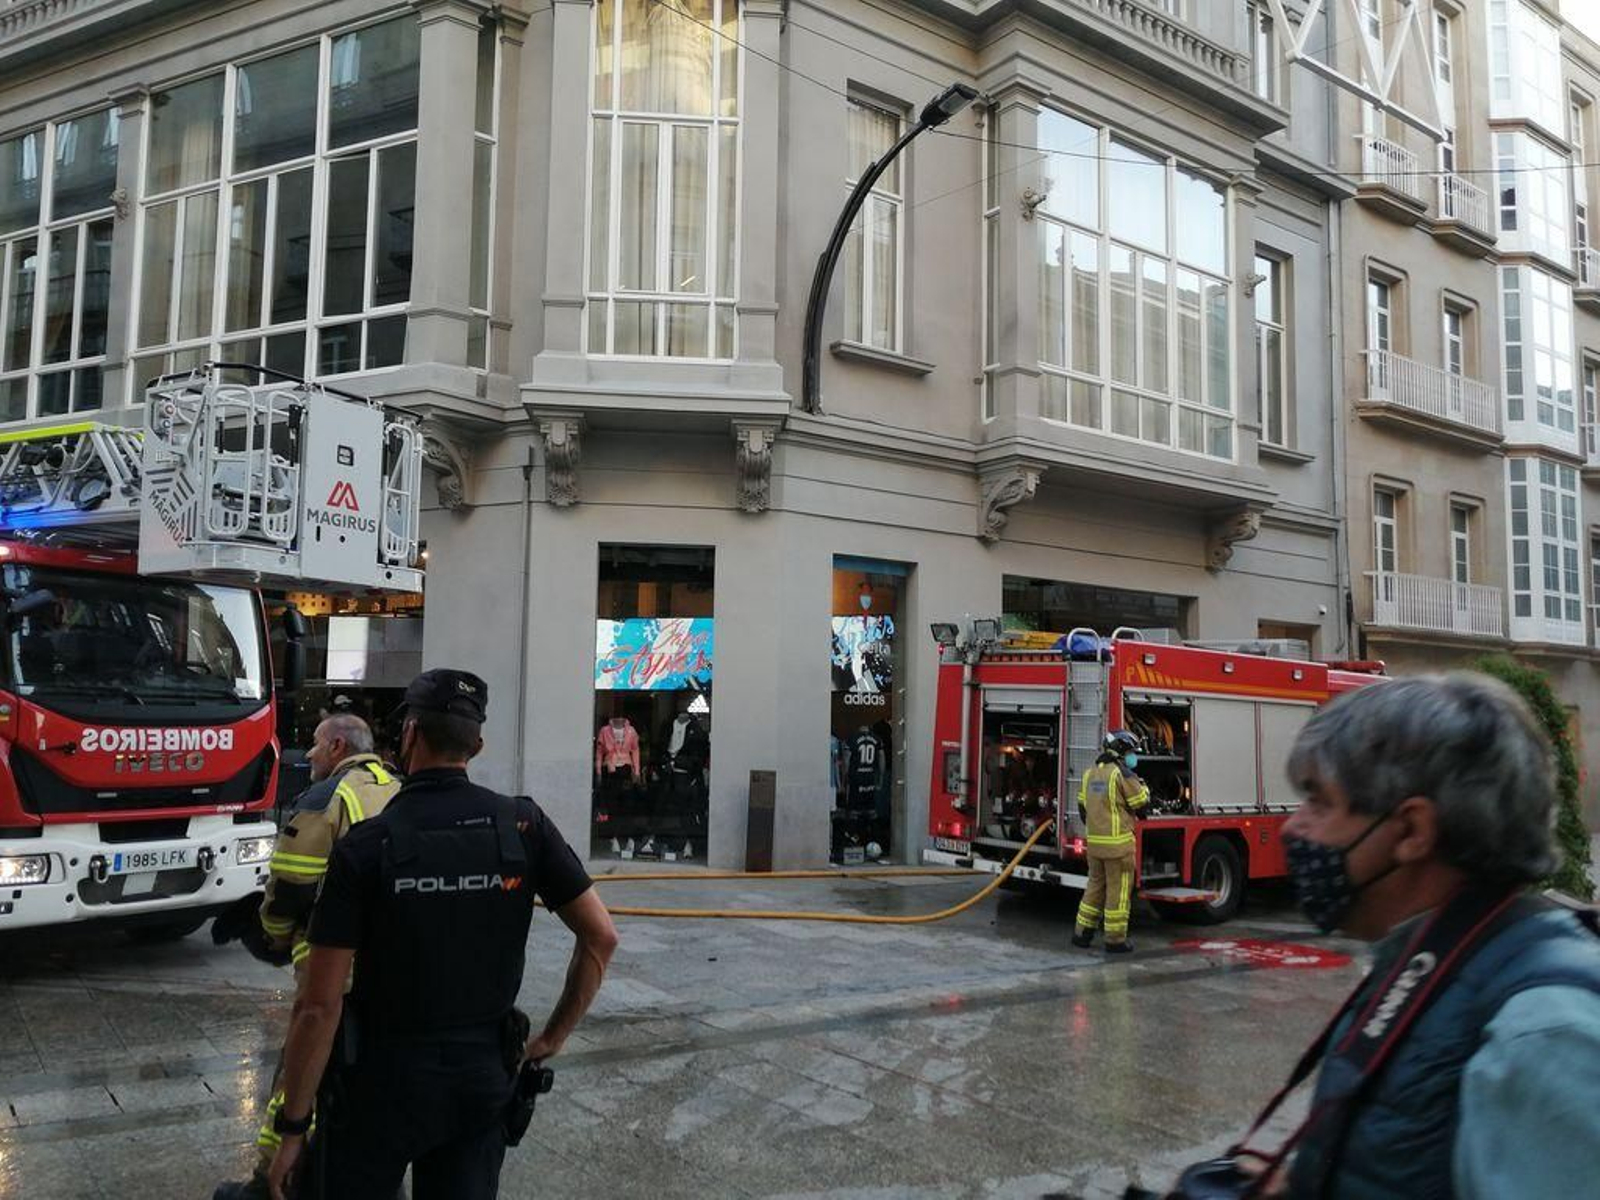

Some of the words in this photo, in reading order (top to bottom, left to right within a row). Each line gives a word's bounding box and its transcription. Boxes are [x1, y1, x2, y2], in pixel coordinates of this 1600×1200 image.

[306, 507, 376, 533] MAGIRUS
[844, 690, 885, 705] adidas
[115, 752, 204, 774] IVECO
[858, 744, 875, 764] 10
[126, 853, 158, 868] 1985
[161, 850, 187, 866] LFK
[395, 875, 504, 894] POLICIA
